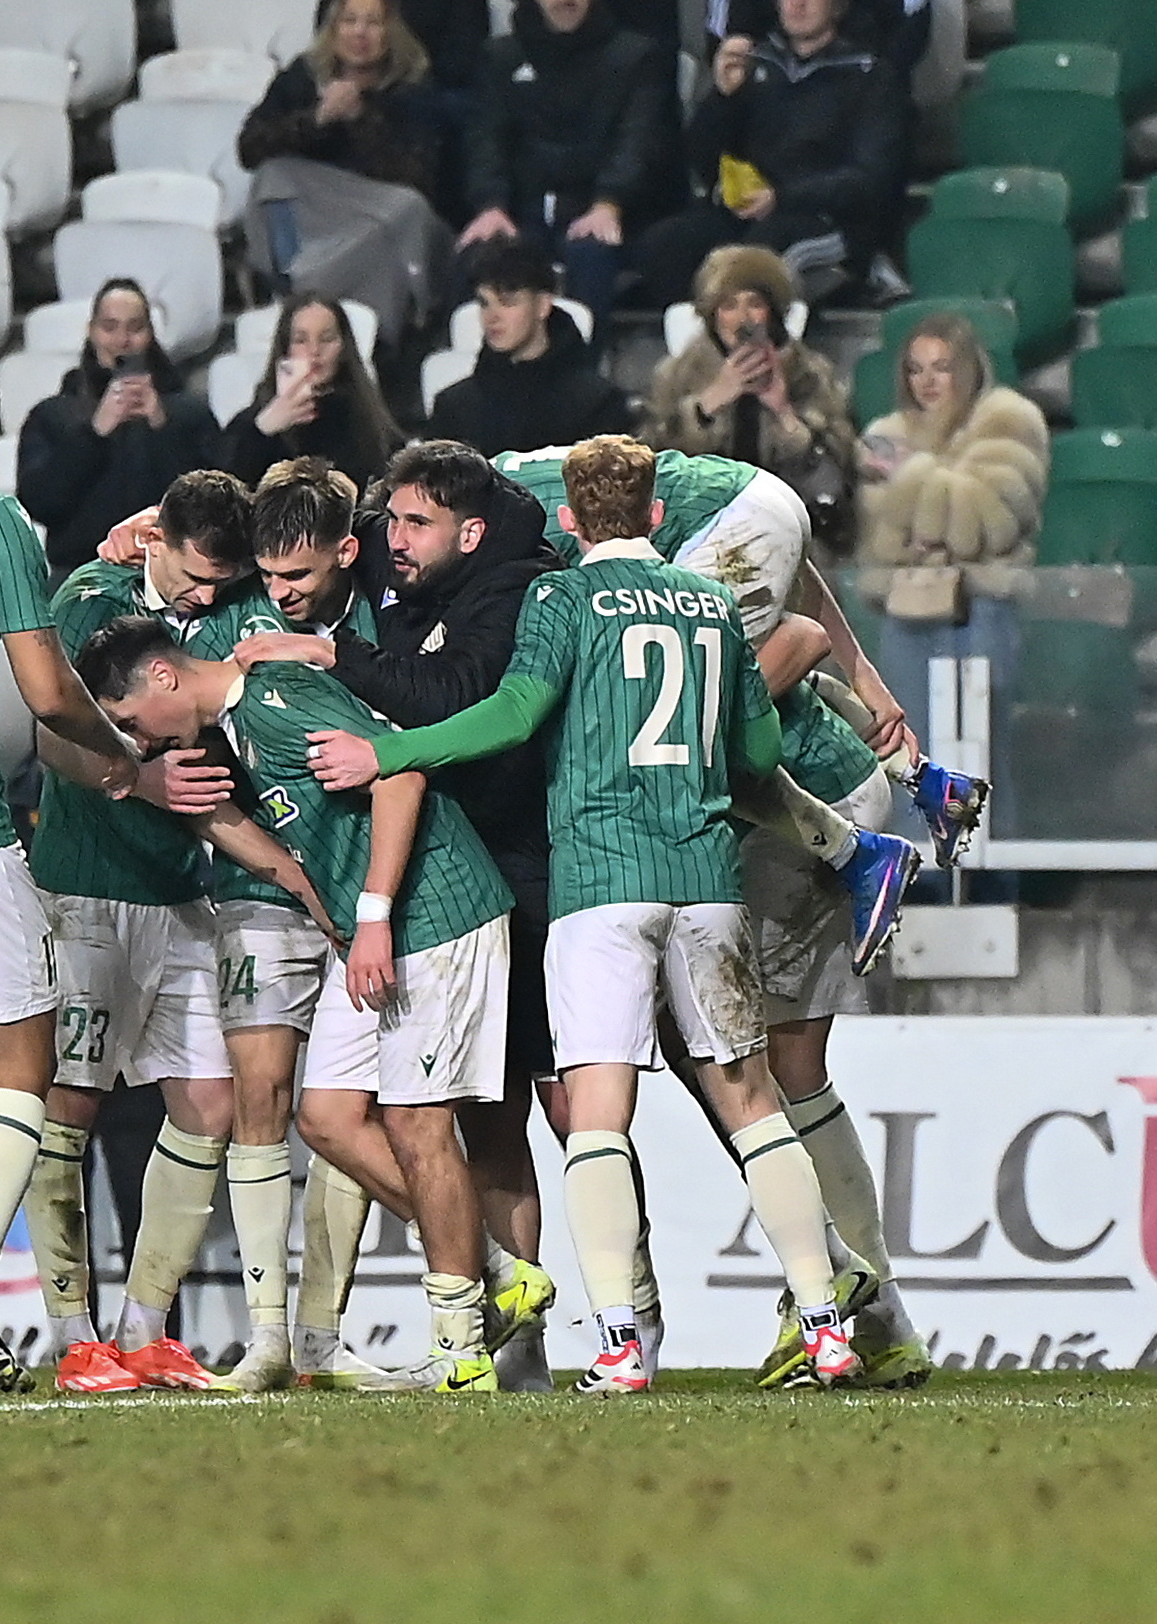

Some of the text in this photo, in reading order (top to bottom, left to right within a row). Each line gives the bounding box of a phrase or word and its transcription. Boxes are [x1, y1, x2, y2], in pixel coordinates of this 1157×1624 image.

[592, 588, 730, 622] CSINGER
[622, 623, 722, 768] 21
[62, 1006, 110, 1063] 23
